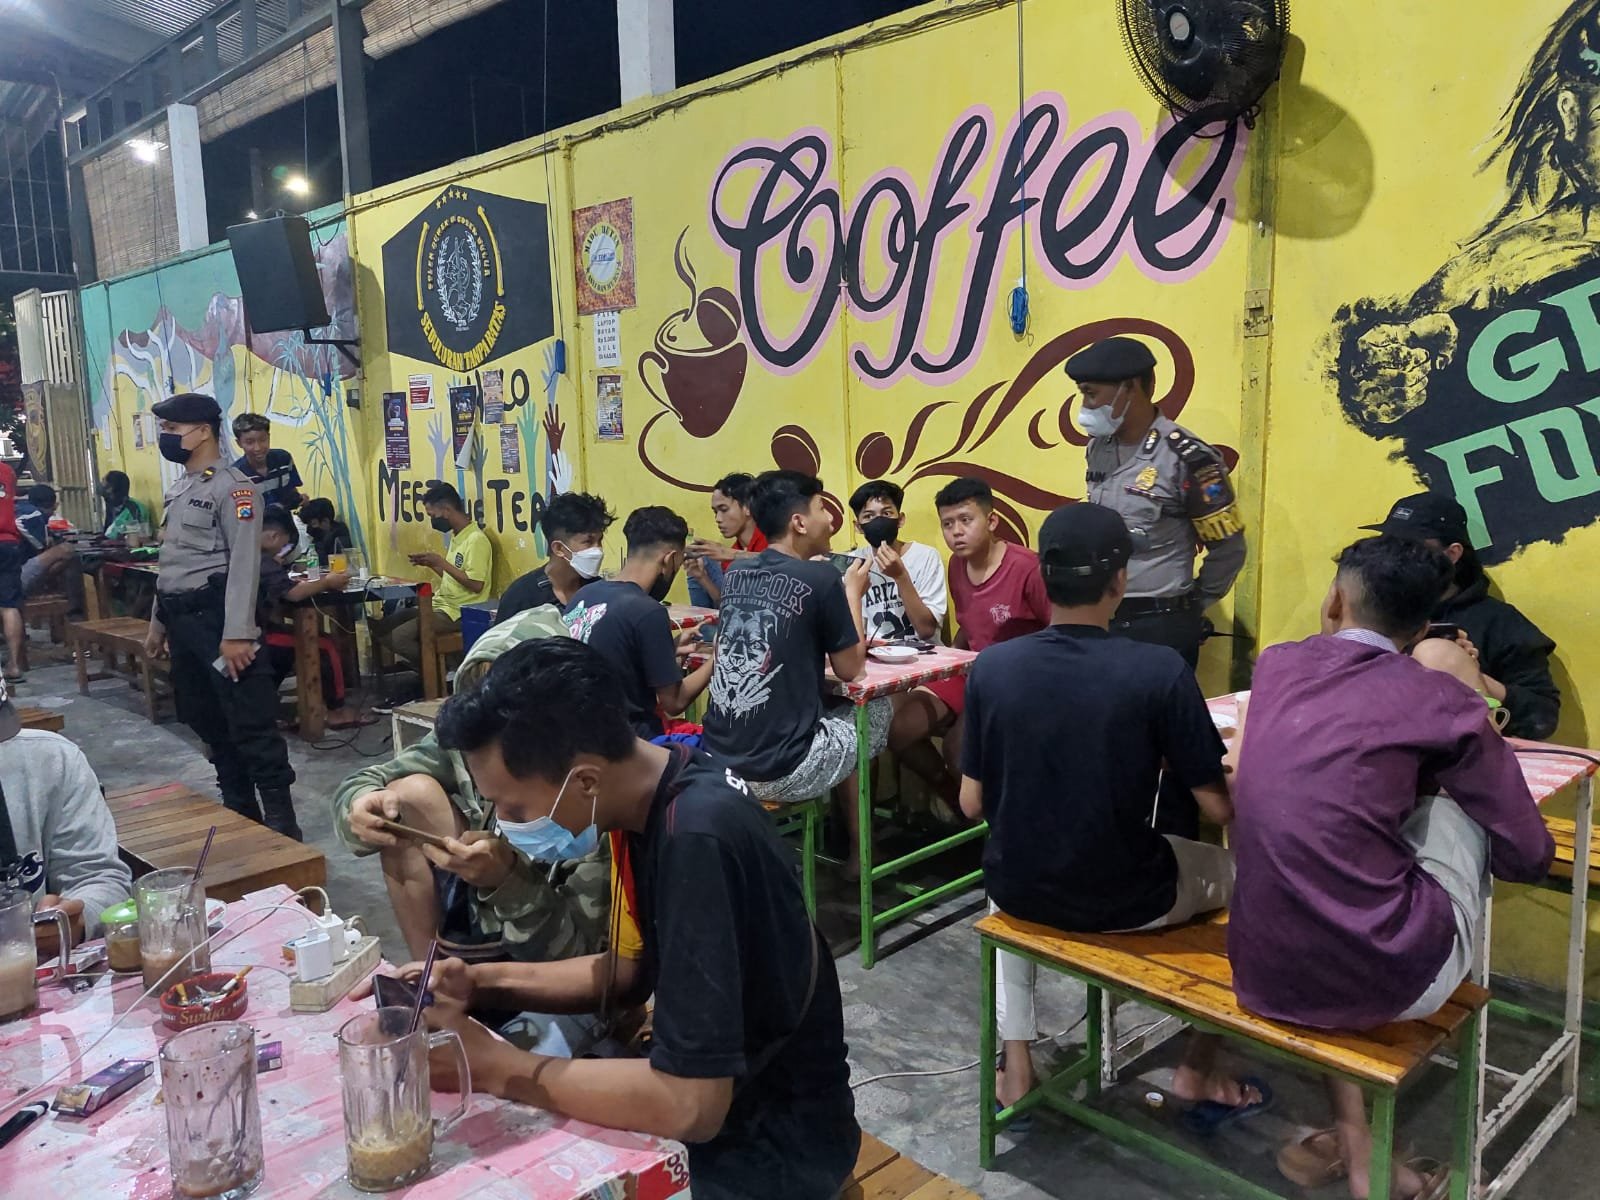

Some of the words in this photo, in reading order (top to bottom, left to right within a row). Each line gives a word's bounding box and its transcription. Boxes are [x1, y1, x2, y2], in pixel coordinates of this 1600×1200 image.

[711, 103, 1240, 379] Coffee
[188, 498, 214, 511] POLRI
[721, 569, 813, 616] ANCOK
